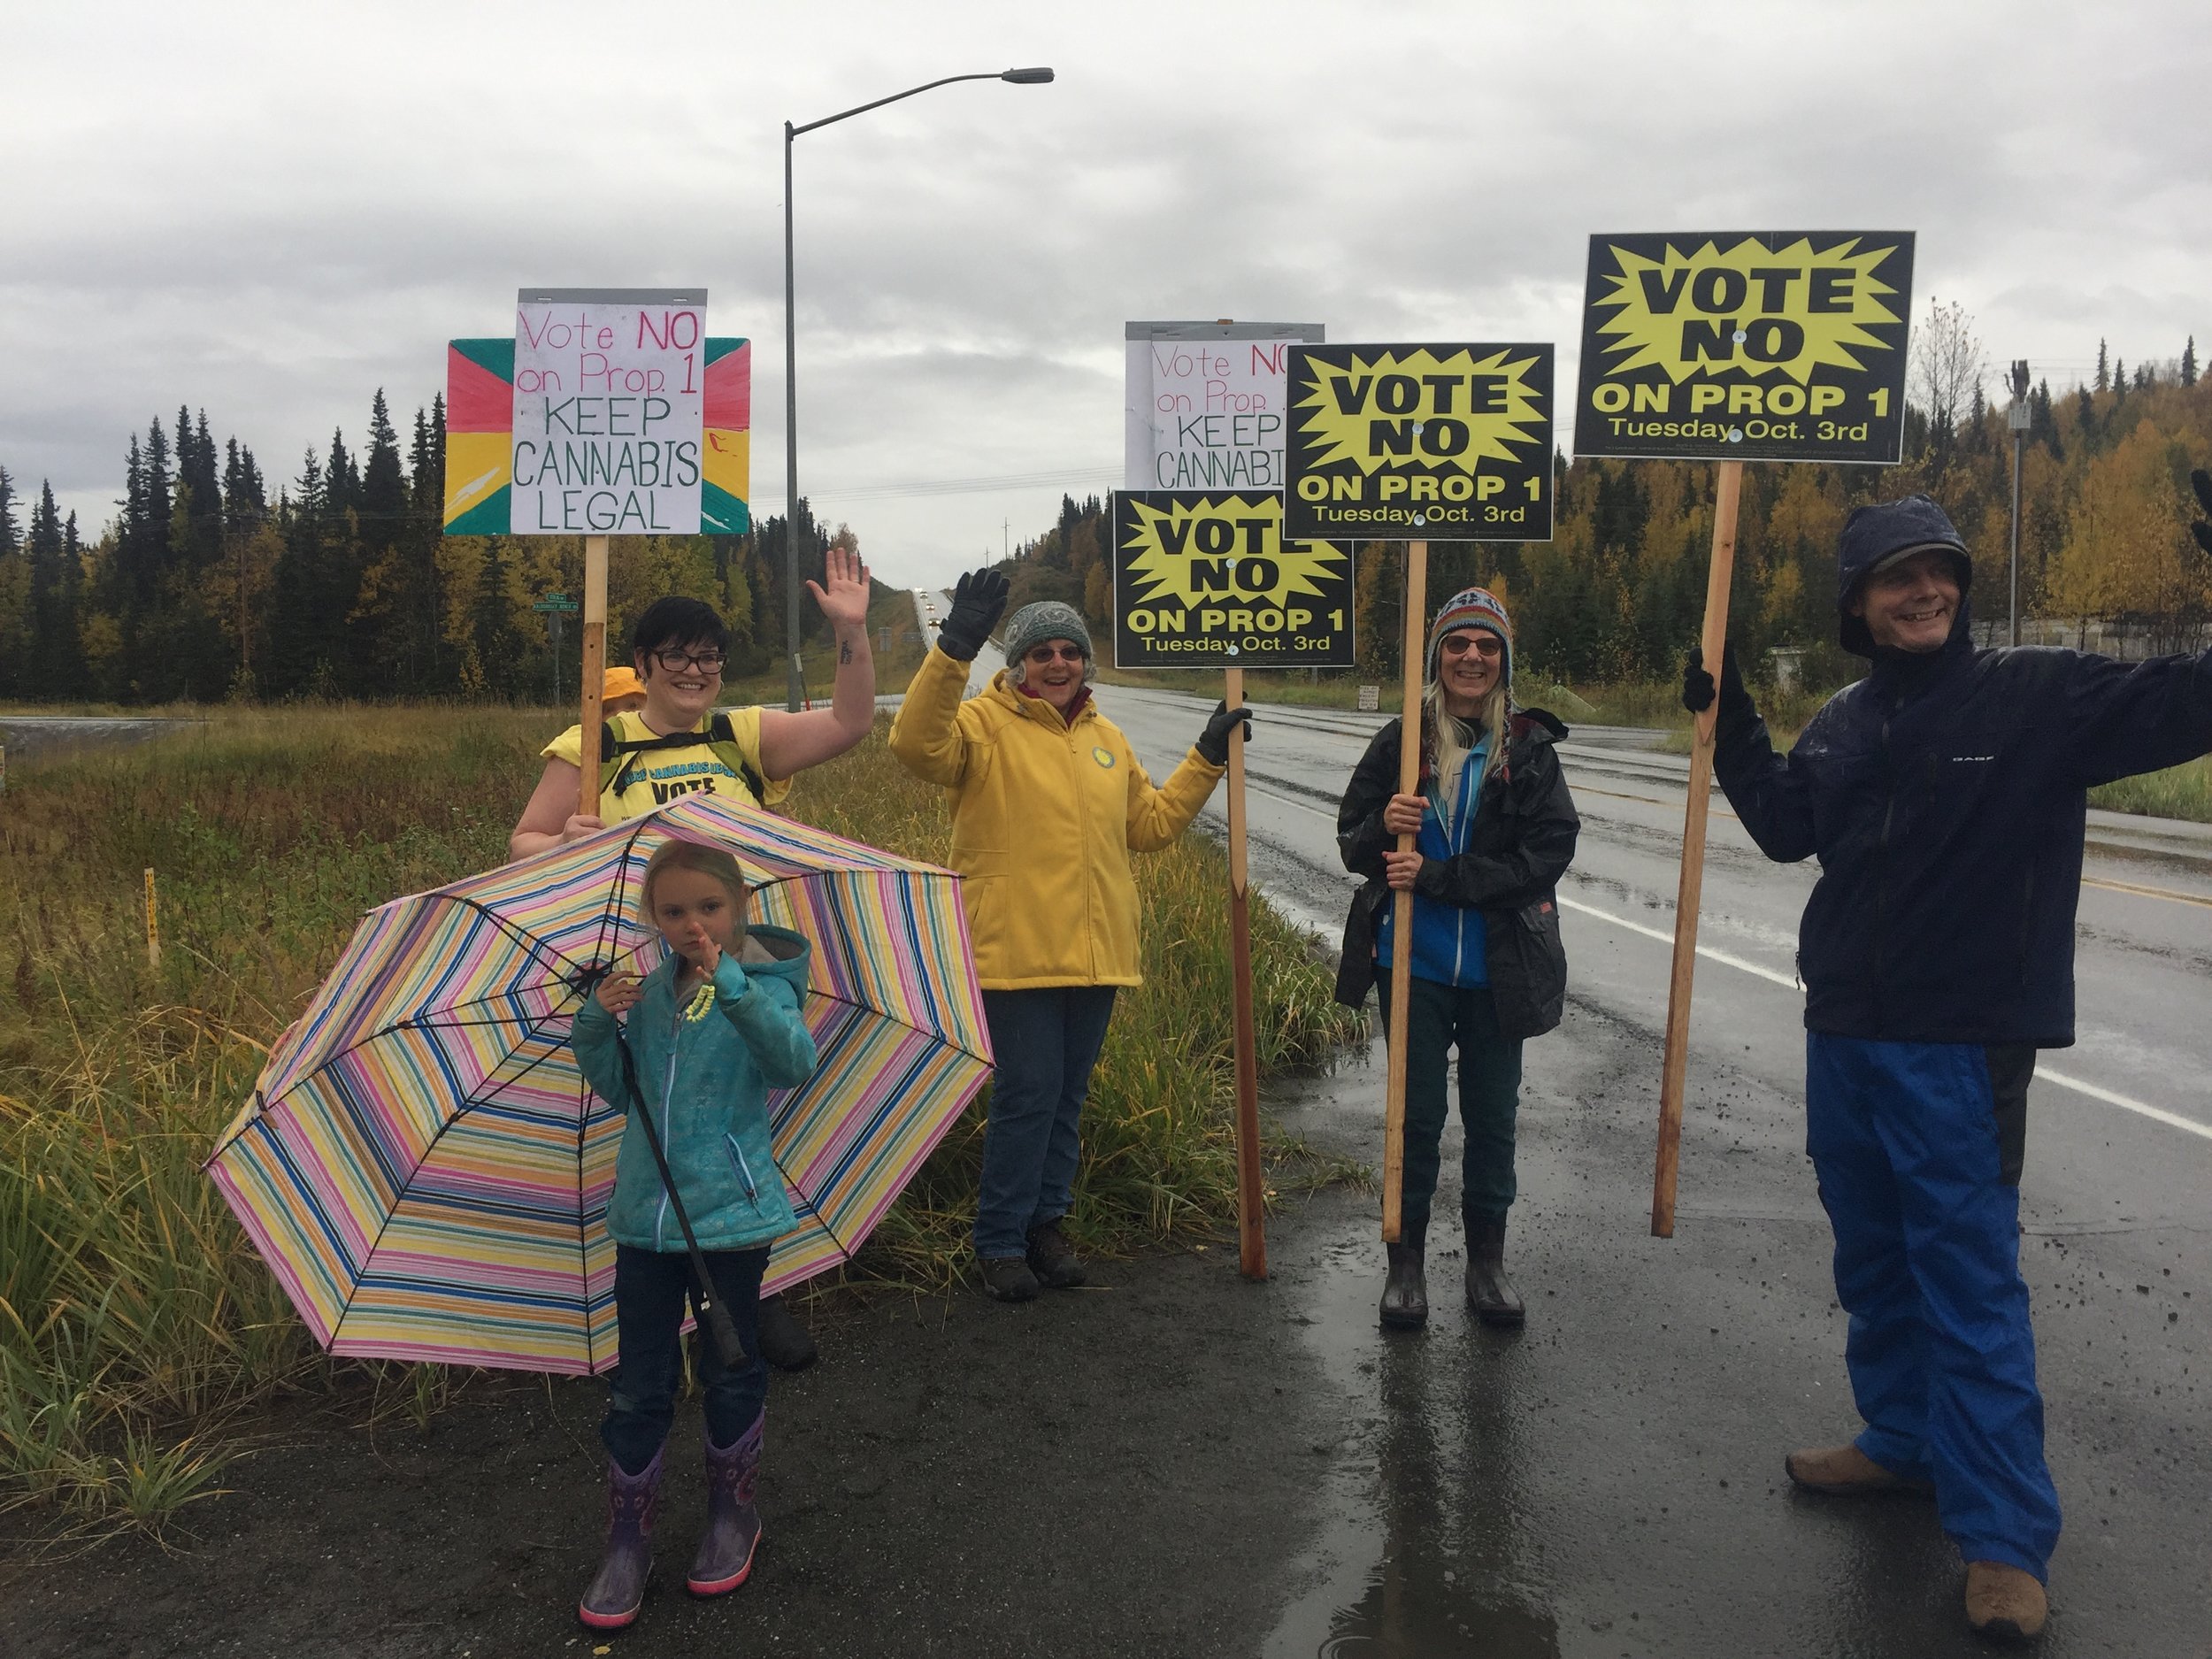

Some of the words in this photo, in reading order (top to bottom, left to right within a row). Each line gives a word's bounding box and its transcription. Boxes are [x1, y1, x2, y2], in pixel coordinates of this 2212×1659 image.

[1638, 267, 1857, 314] VOTE
[519, 311, 613, 349] Vote
[637, 311, 699, 349] NO
[1679, 318, 1805, 363] NO
[517, 369, 562, 393] on
[580, 353, 665, 398] Prop.
[680, 353, 697, 394] 1
[1152, 344, 1232, 378] Vote
[1156, 394, 1192, 412] on
[1206, 380, 1267, 418] Prop.
[1330, 374, 1509, 416] VOTE
[1592, 382, 1671, 413] ON
[1690, 384, 1847, 416] PROP
[1868, 388, 1890, 417] 1
[545, 396, 671, 436] KEEP
[1178, 414, 1281, 448] KEEP
[1608, 418, 1736, 442] Tuesday
[1745, 420, 1806, 440] Oct.
[1816, 421, 1868, 441] 3rd
[1369, 418, 1471, 457] NO
[513, 440, 699, 488] CANNABIS
[1156, 449, 1284, 488] CANNABI
[1297, 475, 1363, 501] ON
[1379, 475, 1506, 501] PROP
[1523, 476, 1540, 501] 1
[539, 490, 671, 531] LEGAL
[1312, 505, 1417, 526] Tuesday
[1425, 506, 1476, 522] Oct.
[1484, 506, 1525, 522] 3rd
[1190, 557, 1280, 592] NO
[1127, 610, 1194, 633] ON
[1202, 609, 1313, 632] PROP
[1328, 610, 1343, 630] 1
[1141, 636, 1235, 655] Tuesday
[1243, 636, 1286, 652] Oct.
[1294, 635, 1331, 650] 3rd
[650, 777, 717, 805] VOTE
